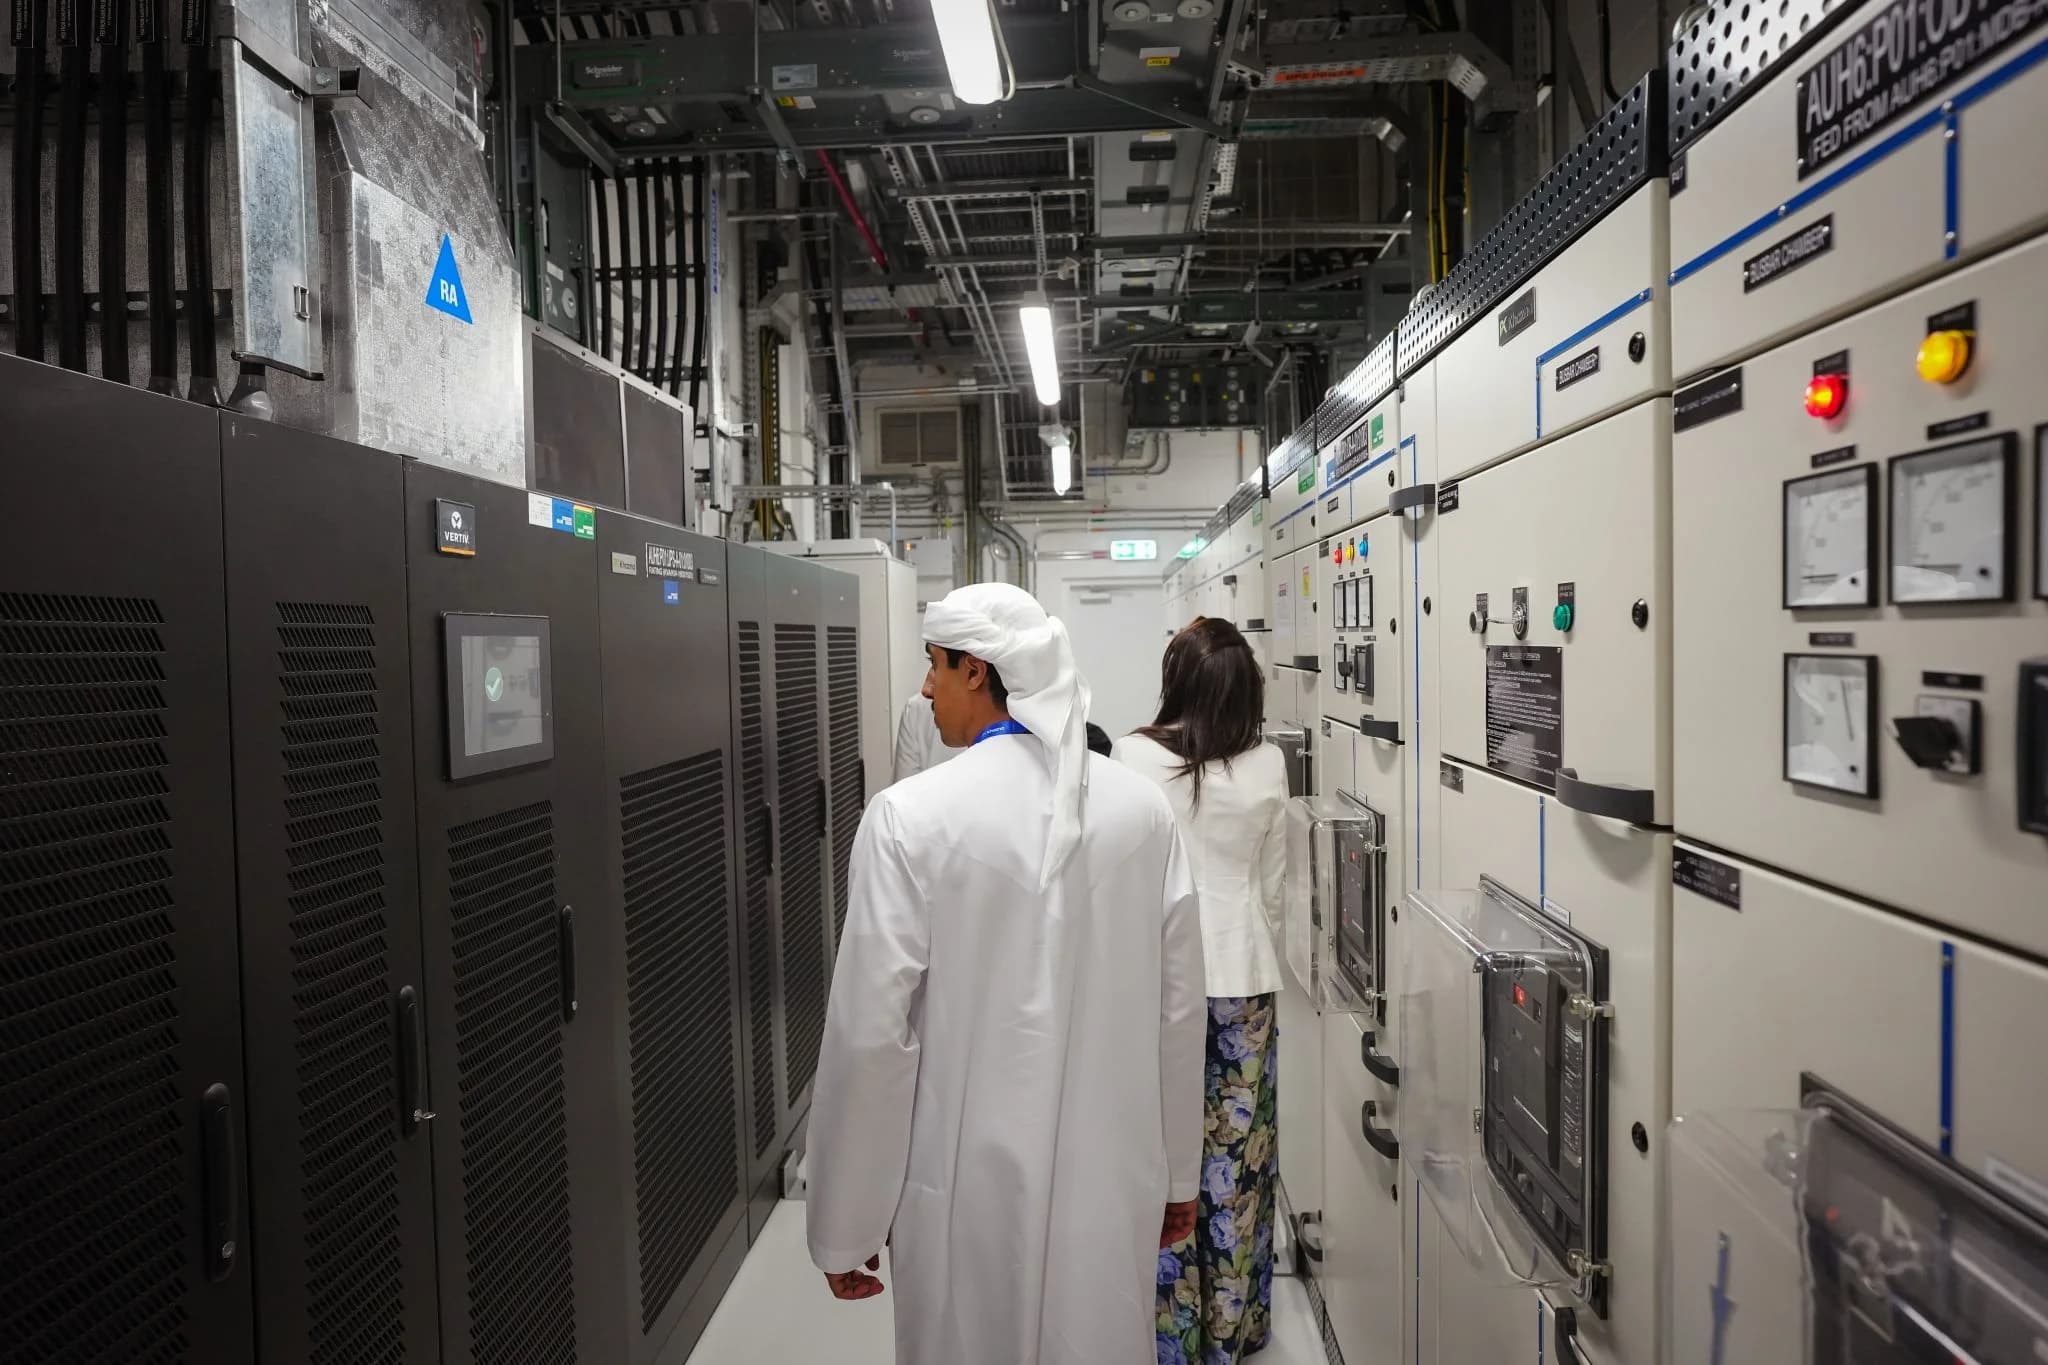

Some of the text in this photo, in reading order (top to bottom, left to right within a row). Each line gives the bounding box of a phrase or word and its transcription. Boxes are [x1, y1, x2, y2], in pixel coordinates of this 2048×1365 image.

[1843, 90, 1889, 143] FROM
[440, 278, 458, 308] RA
[444, 530, 469, 545] VERTIV
